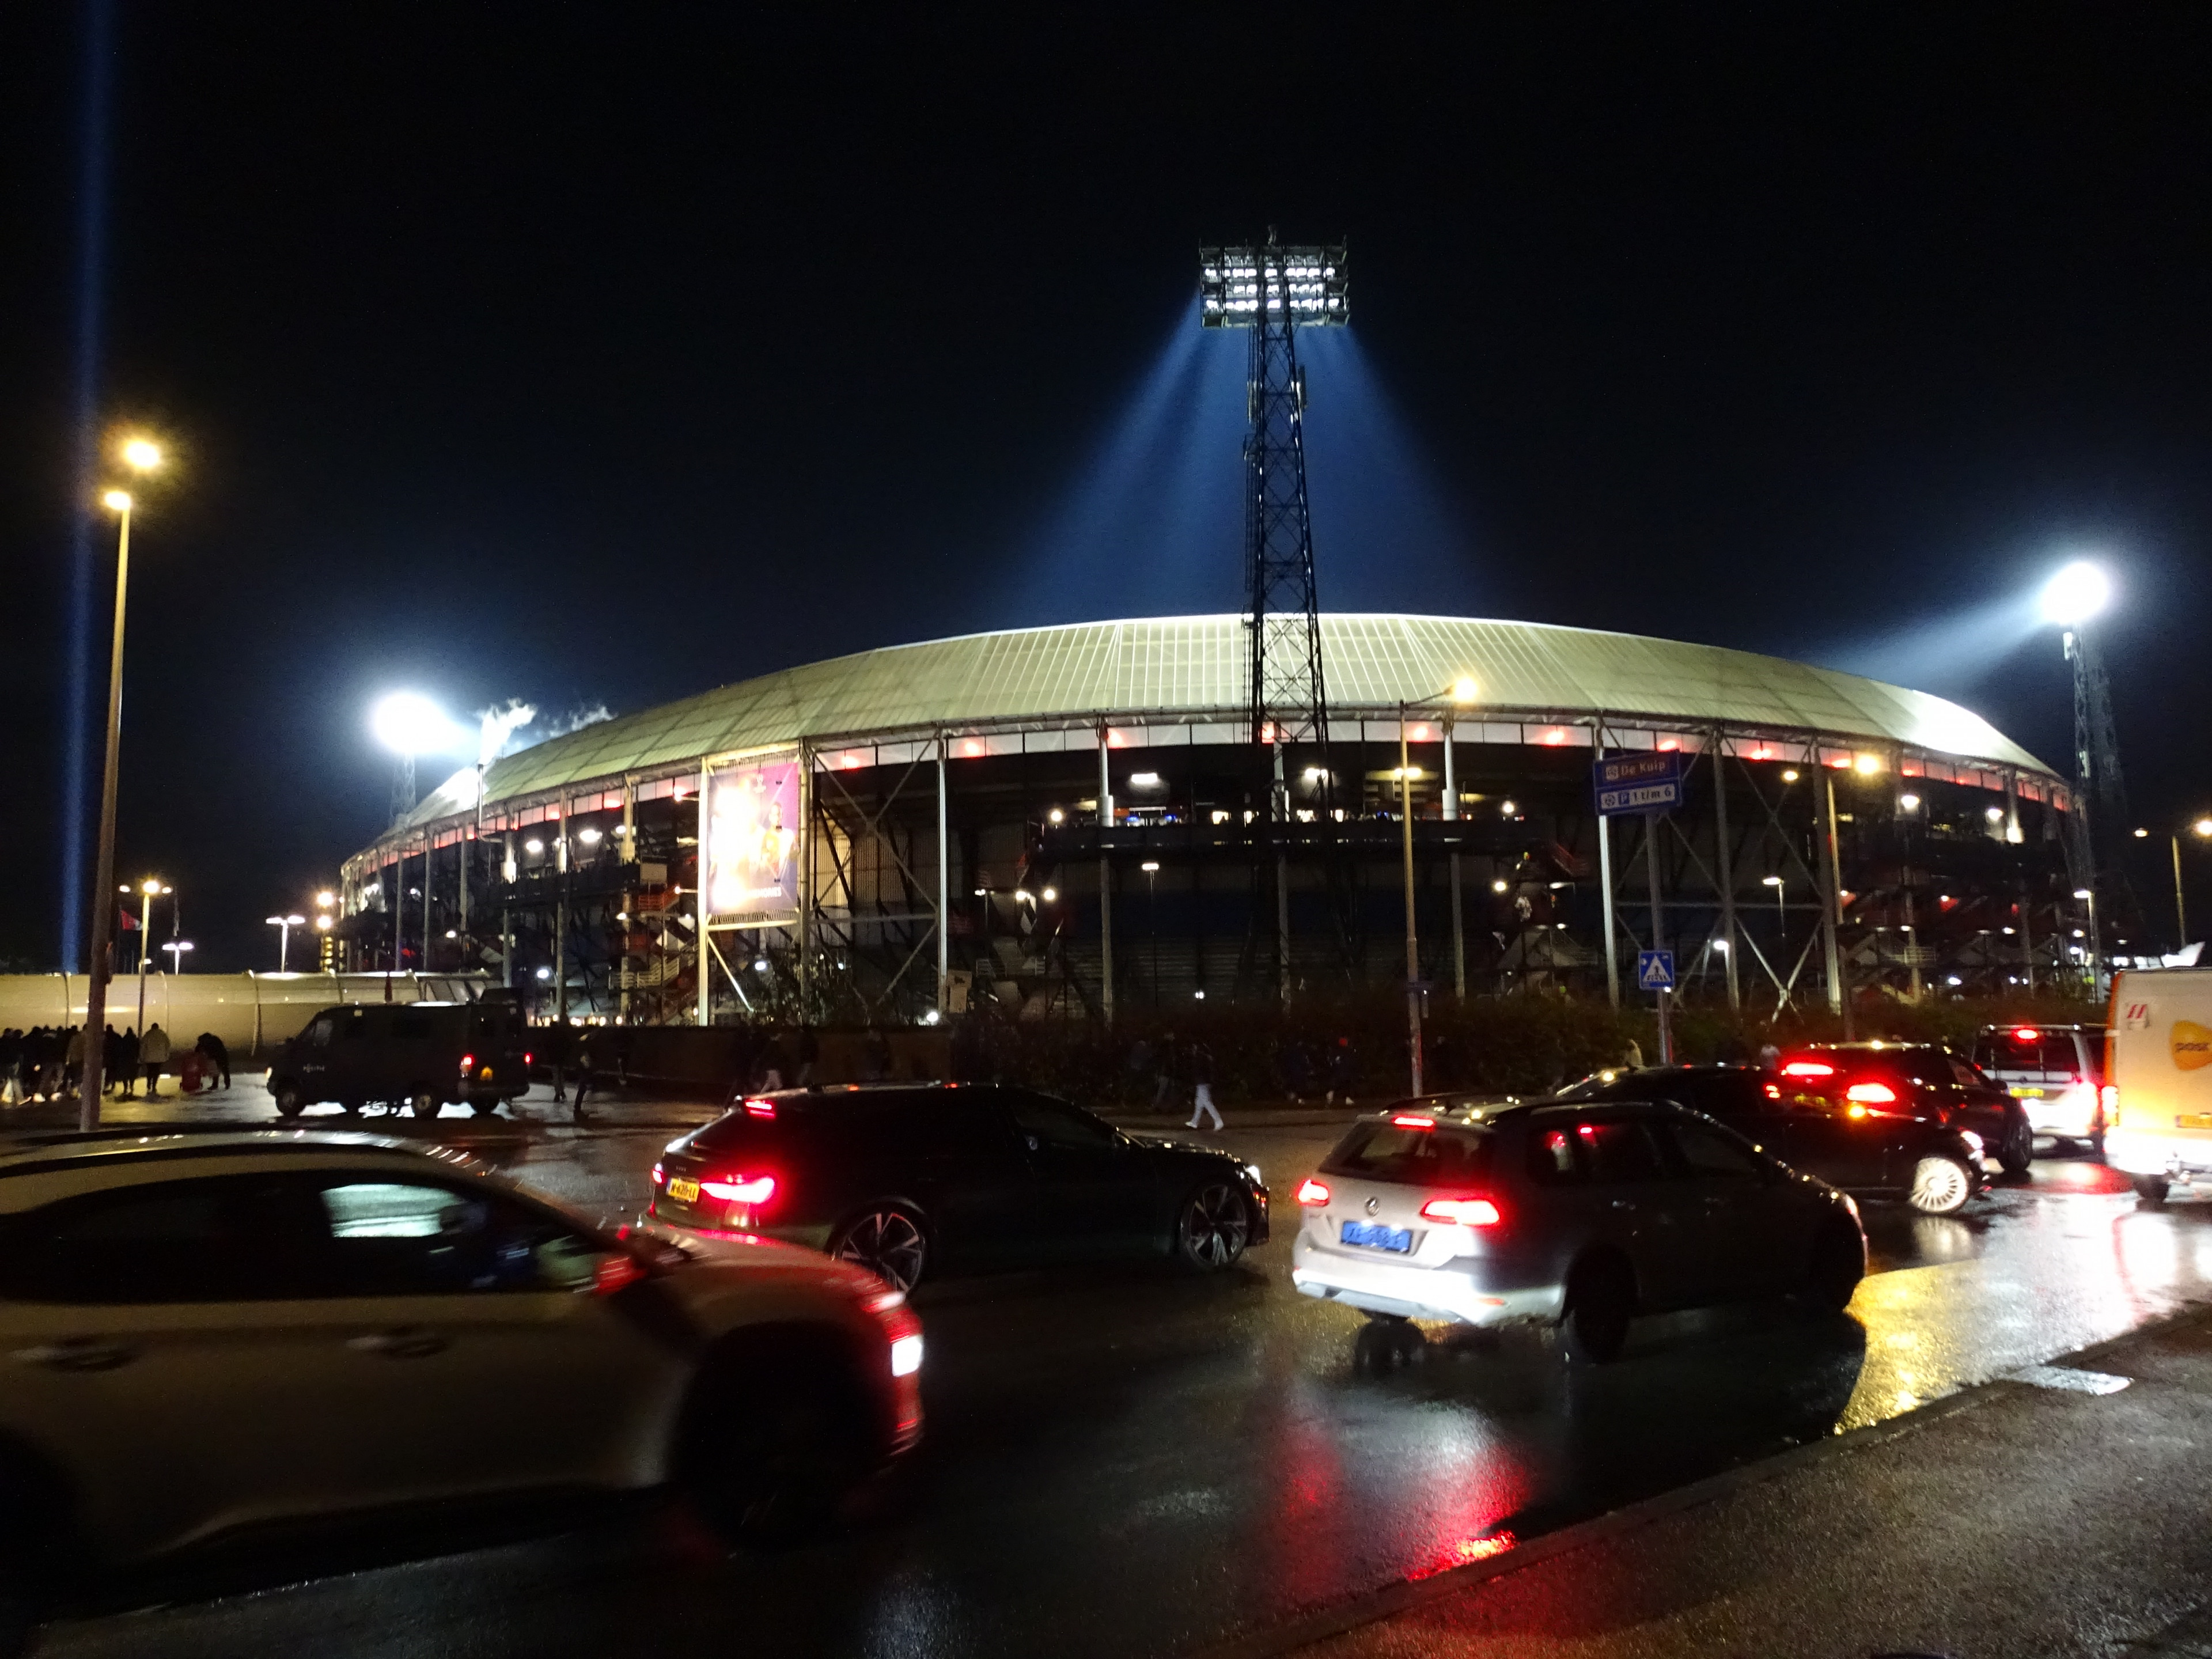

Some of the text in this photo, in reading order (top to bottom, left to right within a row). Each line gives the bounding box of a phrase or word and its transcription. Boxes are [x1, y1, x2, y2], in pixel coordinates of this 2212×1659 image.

[1621, 760, 1666, 776] De Kuip
[1641, 789, 1660, 800] t/m
[1665, 787, 1671, 797] 6
